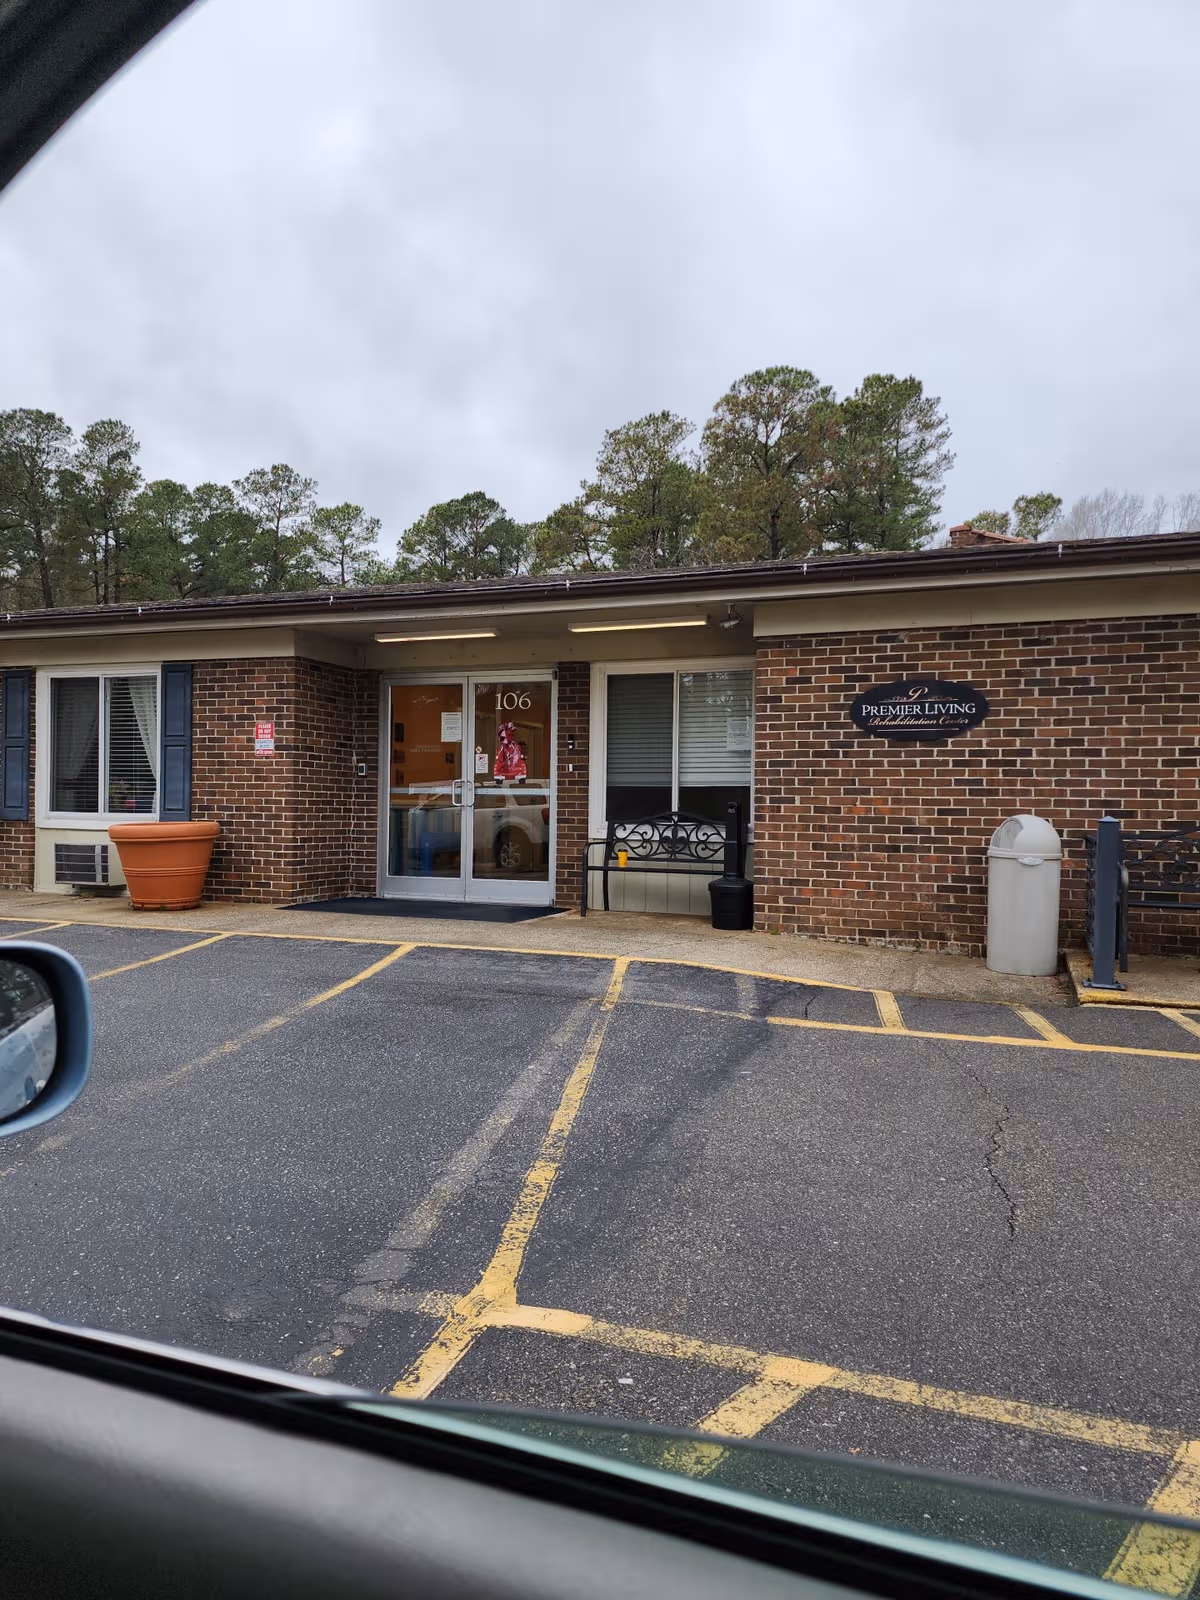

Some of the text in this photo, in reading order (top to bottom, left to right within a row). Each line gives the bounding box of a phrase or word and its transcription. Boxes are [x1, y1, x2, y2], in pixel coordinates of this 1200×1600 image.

[495, 692, 531, 710] 106
[862, 703, 976, 716] PREMIER LIVING
[867, 715, 969, 726] Rehabilitation Center
